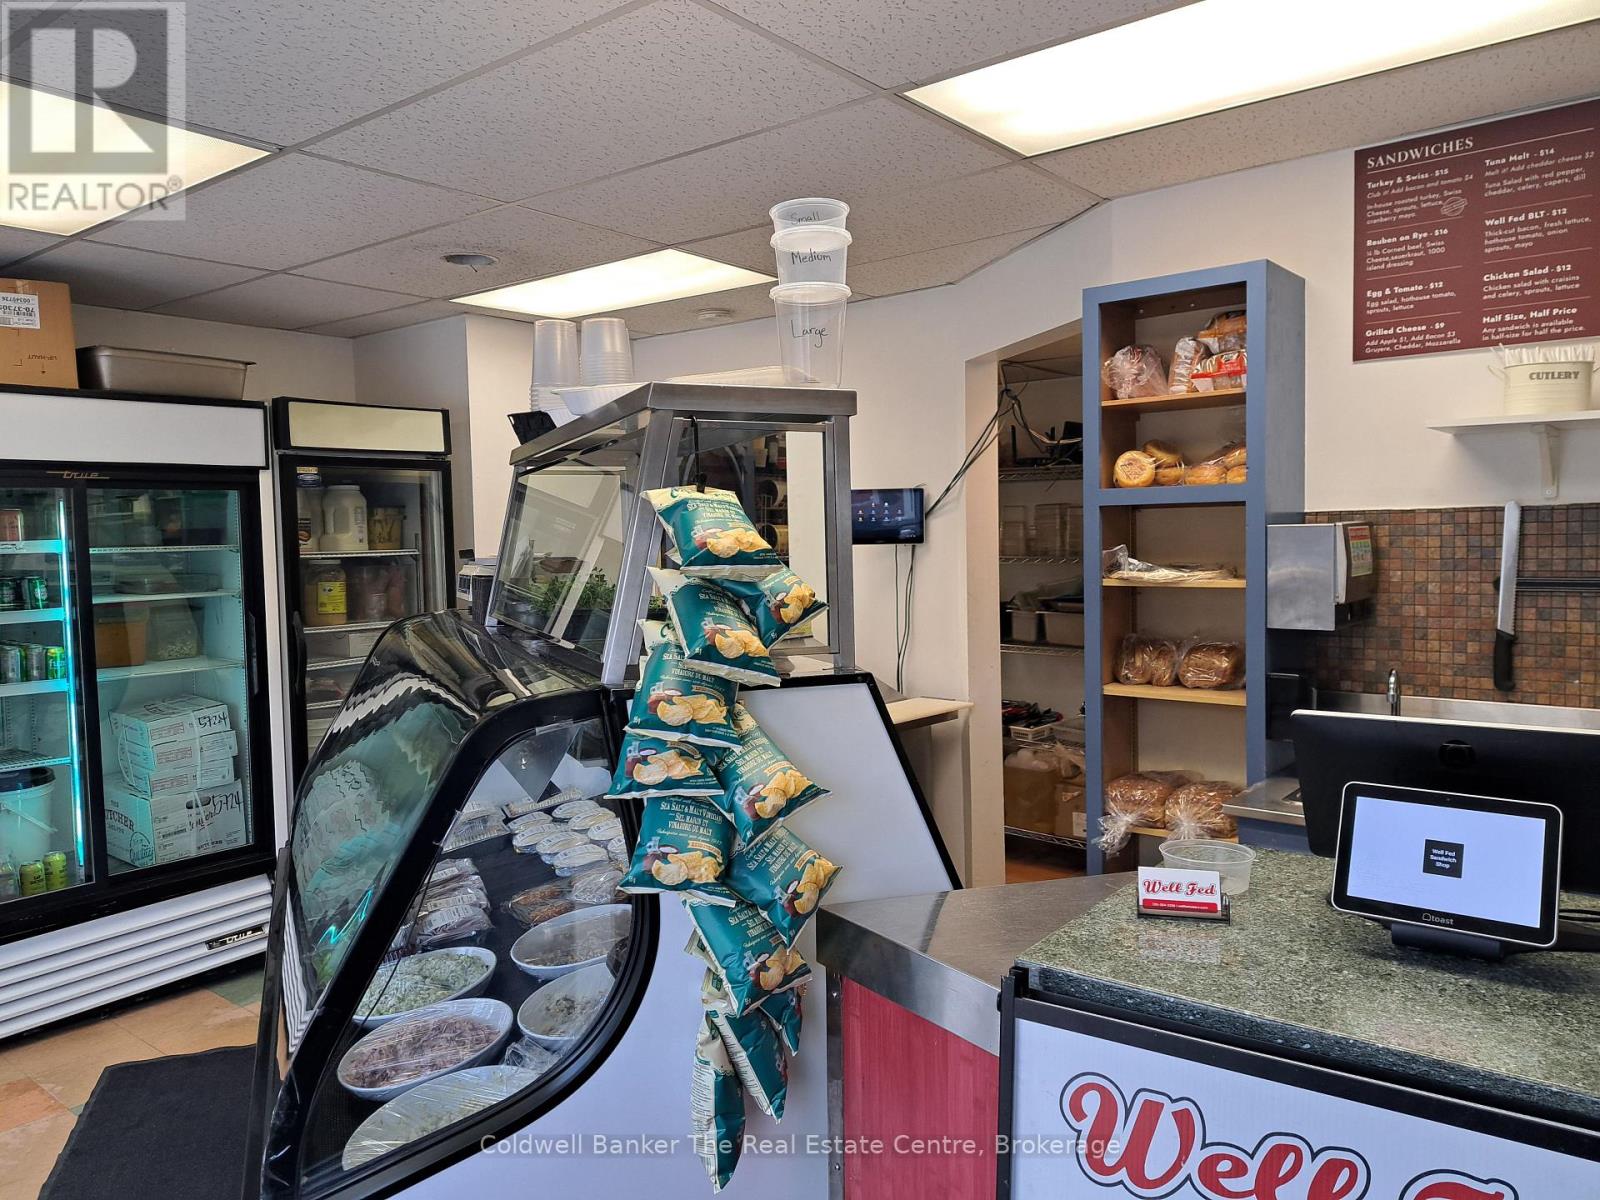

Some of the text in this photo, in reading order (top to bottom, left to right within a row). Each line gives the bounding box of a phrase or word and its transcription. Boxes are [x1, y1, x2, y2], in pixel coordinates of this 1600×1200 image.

[1366, 136, 1474, 169] SANDWICHES
[1484, 148, 1555, 166] Tuna Melt $14
[1510, 164, 1525, 172] Add
[1526, 159, 1555, 169] cheddar
[1557, 154, 1582, 163] cheese
[1367, 179, 1393, 189] Turkey
[1405, 172, 1429, 181] Swiss
[1434, 168, 1449, 176] $15
[1440, 177, 1462, 185] tomato
[1502, 177, 1522, 185] Salad
[1573, 173, 1586, 181] dill
[1394, 196, 1418, 205] roasted
[790, 210, 820, 225] Small
[1367, 212, 1415, 224] cranberry mayo
[1484, 216, 1505, 226] Well
[1508, 213, 1525, 222] Fed
[1528, 210, 1545, 219] BLT
[1544, 220, 1562, 228] fresh
[1366, 237, 1396, 246] Reuben
[1412, 231, 1428, 239] Rye
[1434, 228, 1448, 236] $16
[1484, 236, 1516, 245] hothouse
[1382, 245, 1405, 254] Corned
[1428, 246, 1445, 254] 1000
[1514, 241, 1533, 249] mayo
[791, 247, 831, 264] Medium
[1386, 260, 1414, 268] dressing
[1483, 264, 1571, 281] Chicken Salad $12
[1483, 284, 1511, 292] Chicken
[1513, 280, 1532, 288] salad
[1551, 274, 1579, 283] craisins
[1555, 282, 1580, 290] lettuce
[1366, 289, 1382, 298] Egg
[1393, 284, 1423, 293] Tomato
[1401, 294, 1430, 302] hothouse
[1482, 307, 1577, 323] Half Size, Half Price
[1497, 322, 1530, 331] sandwich
[1540, 318, 1573, 327] available
[790, 319, 829, 348] Large
[1365, 327, 1393, 336] Grilled
[1396, 325, 1426, 333] Cheese
[1521, 328, 1532, 337] for
[1534, 327, 1548, 335] half
[1550, 326, 1561, 334] the
[1379, 337, 1397, 345] Apple
[1425, 338, 1461, 346] Mozzarella
[1529, 370, 1579, 380] CUTLERY
[660, 801, 670, 810] SEA
[671, 802, 684, 812] SALT
[1429, 854, 1456, 863] Sandwich
[1143, 880, 1216, 895] Well Fed
[1431, 915, 1453, 925] toast
